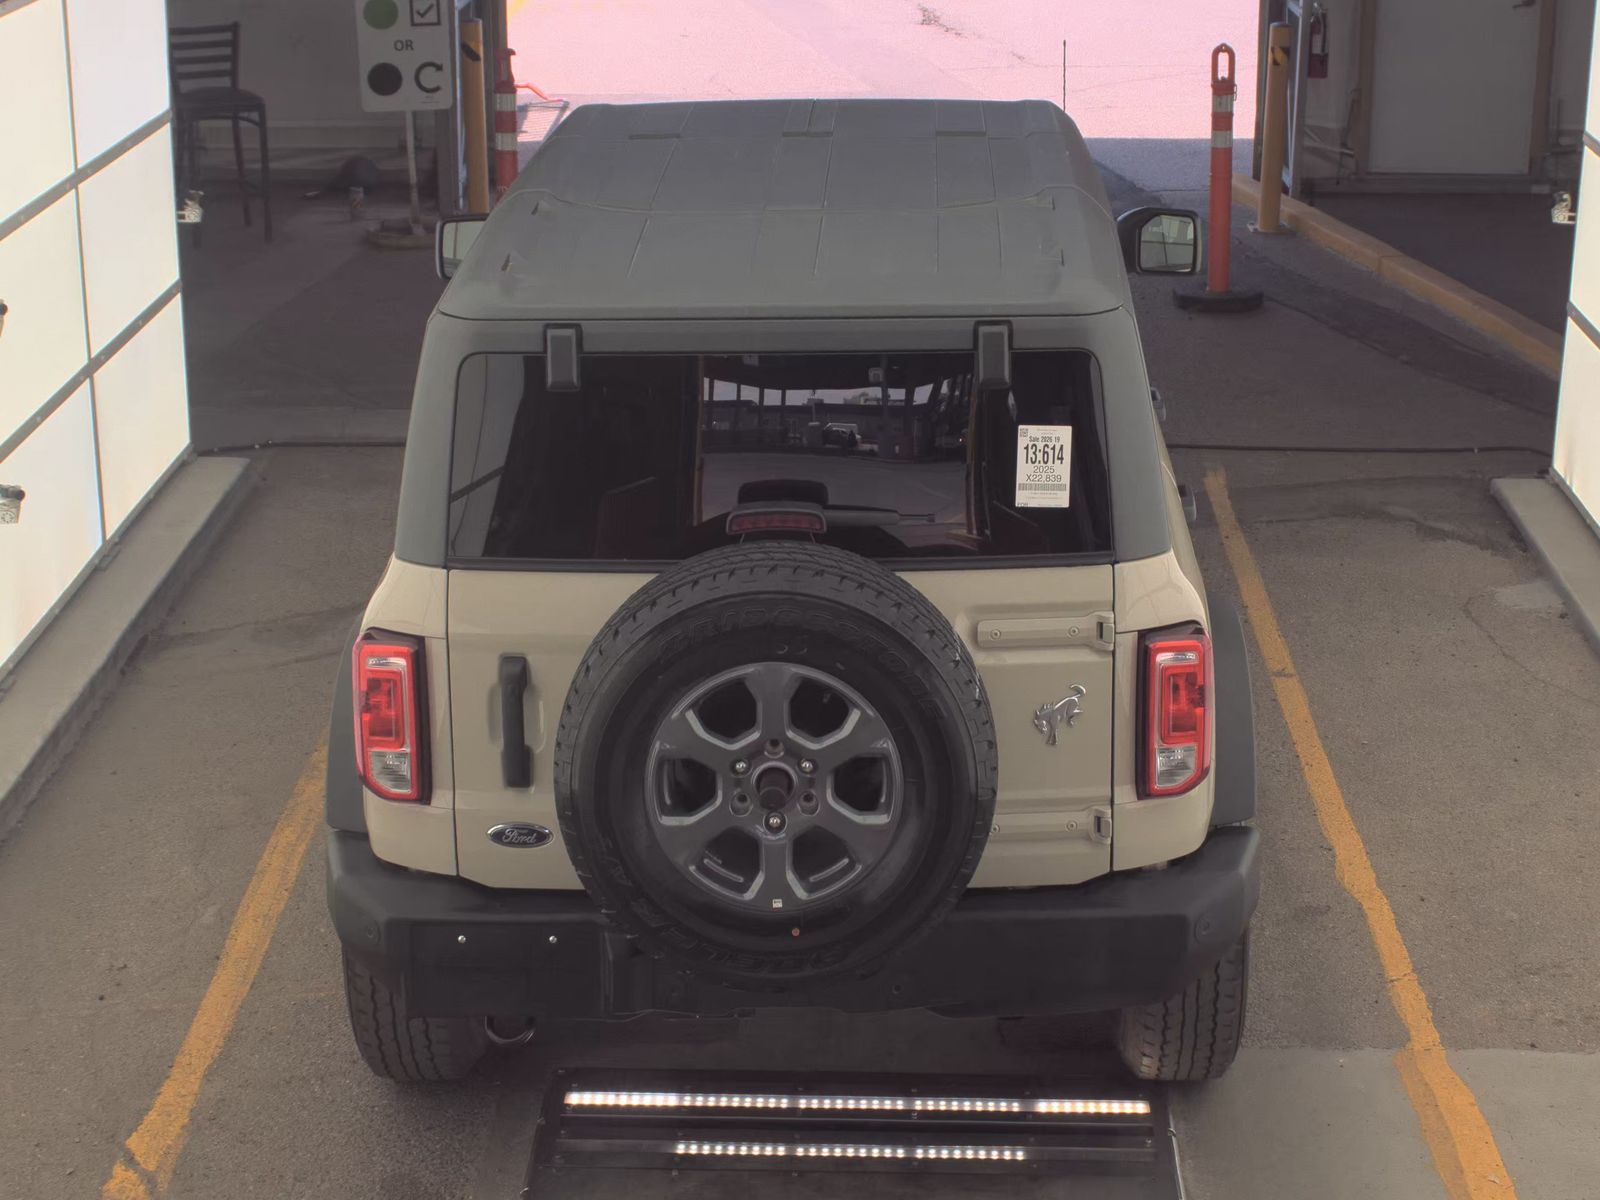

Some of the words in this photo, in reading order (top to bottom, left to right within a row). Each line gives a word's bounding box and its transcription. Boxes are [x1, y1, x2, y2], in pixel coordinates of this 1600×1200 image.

[393, 39, 415, 52] OR
[1024, 443, 1064, 465] 13:614
[1033, 465, 1055, 474] 2025
[1026, 474, 1062, 483] X22,839
[502, 828, 537, 844] Ford
